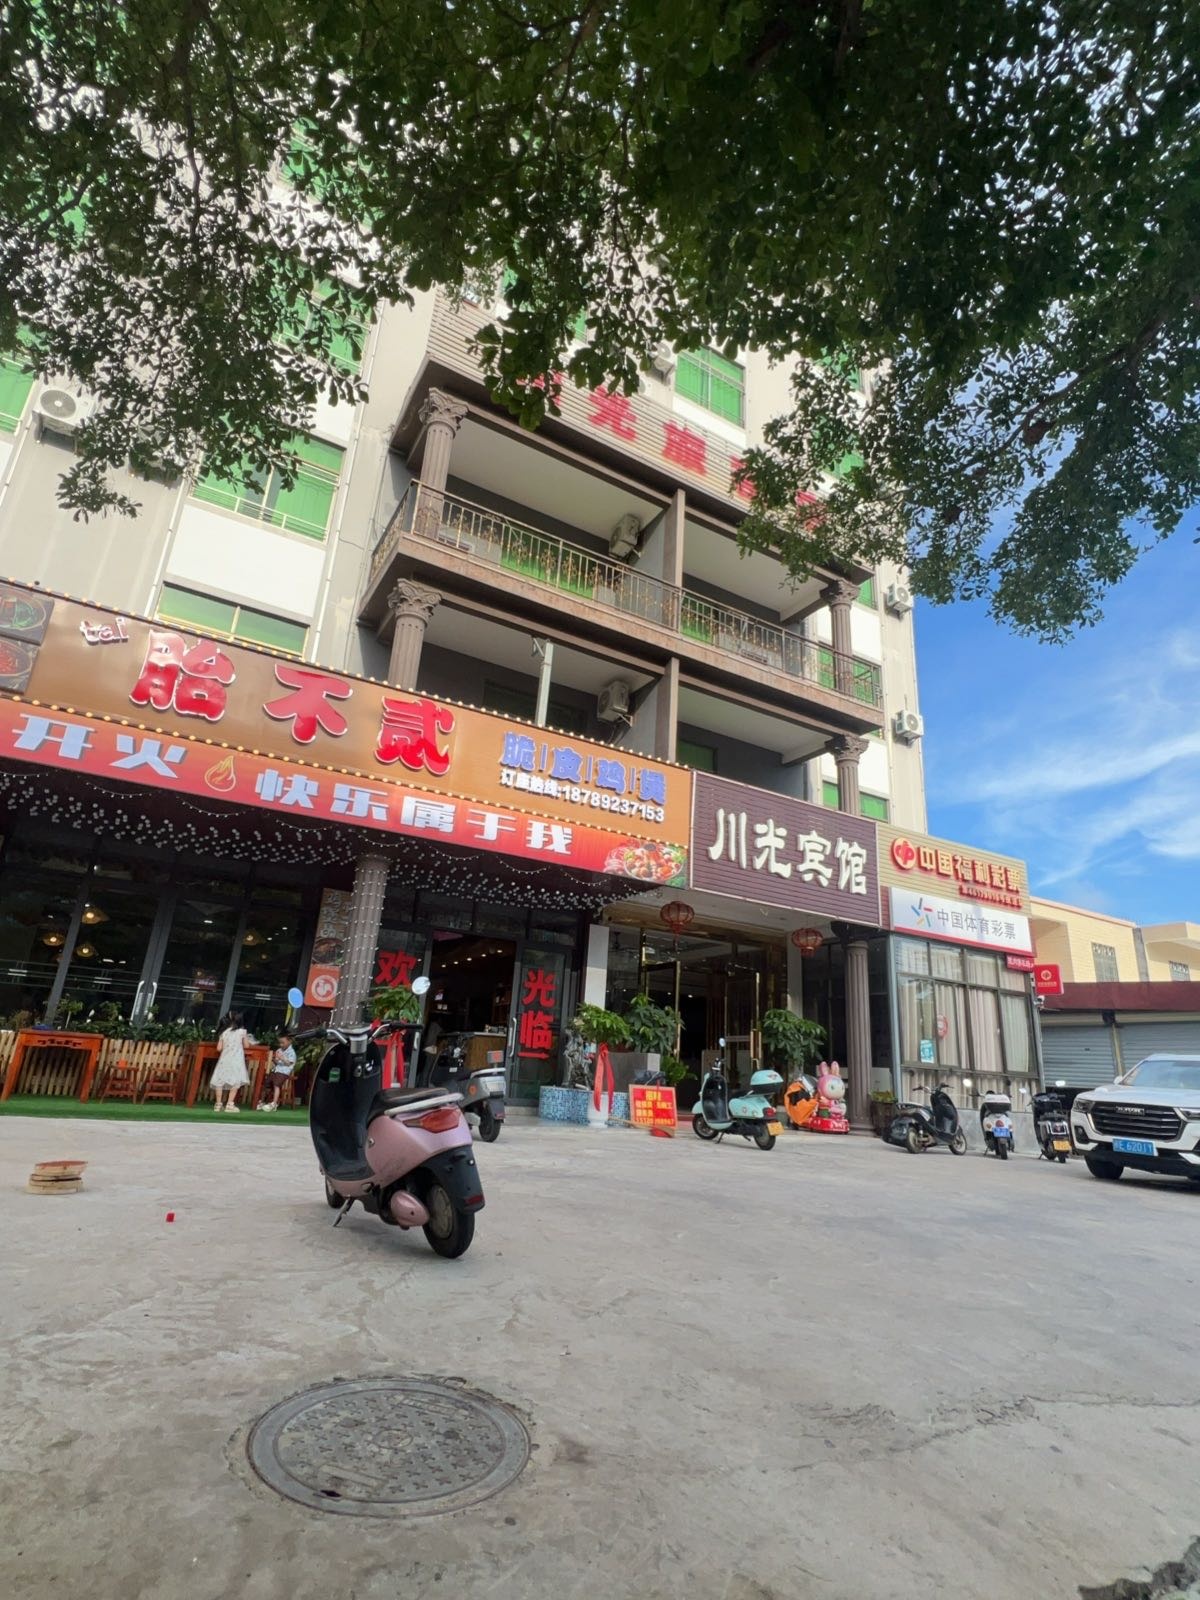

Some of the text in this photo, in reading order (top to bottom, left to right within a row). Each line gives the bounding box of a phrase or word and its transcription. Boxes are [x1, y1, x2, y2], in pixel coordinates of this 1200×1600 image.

[12, 712, 572, 855] 开火 快乐属于我
[708, 808, 867, 895] 川光宾馆
[918, 845, 1021, 893] 中国福利彩票
[937, 909, 1016, 940] 中国体育彩票
[519, 968, 558, 1050] 光临
